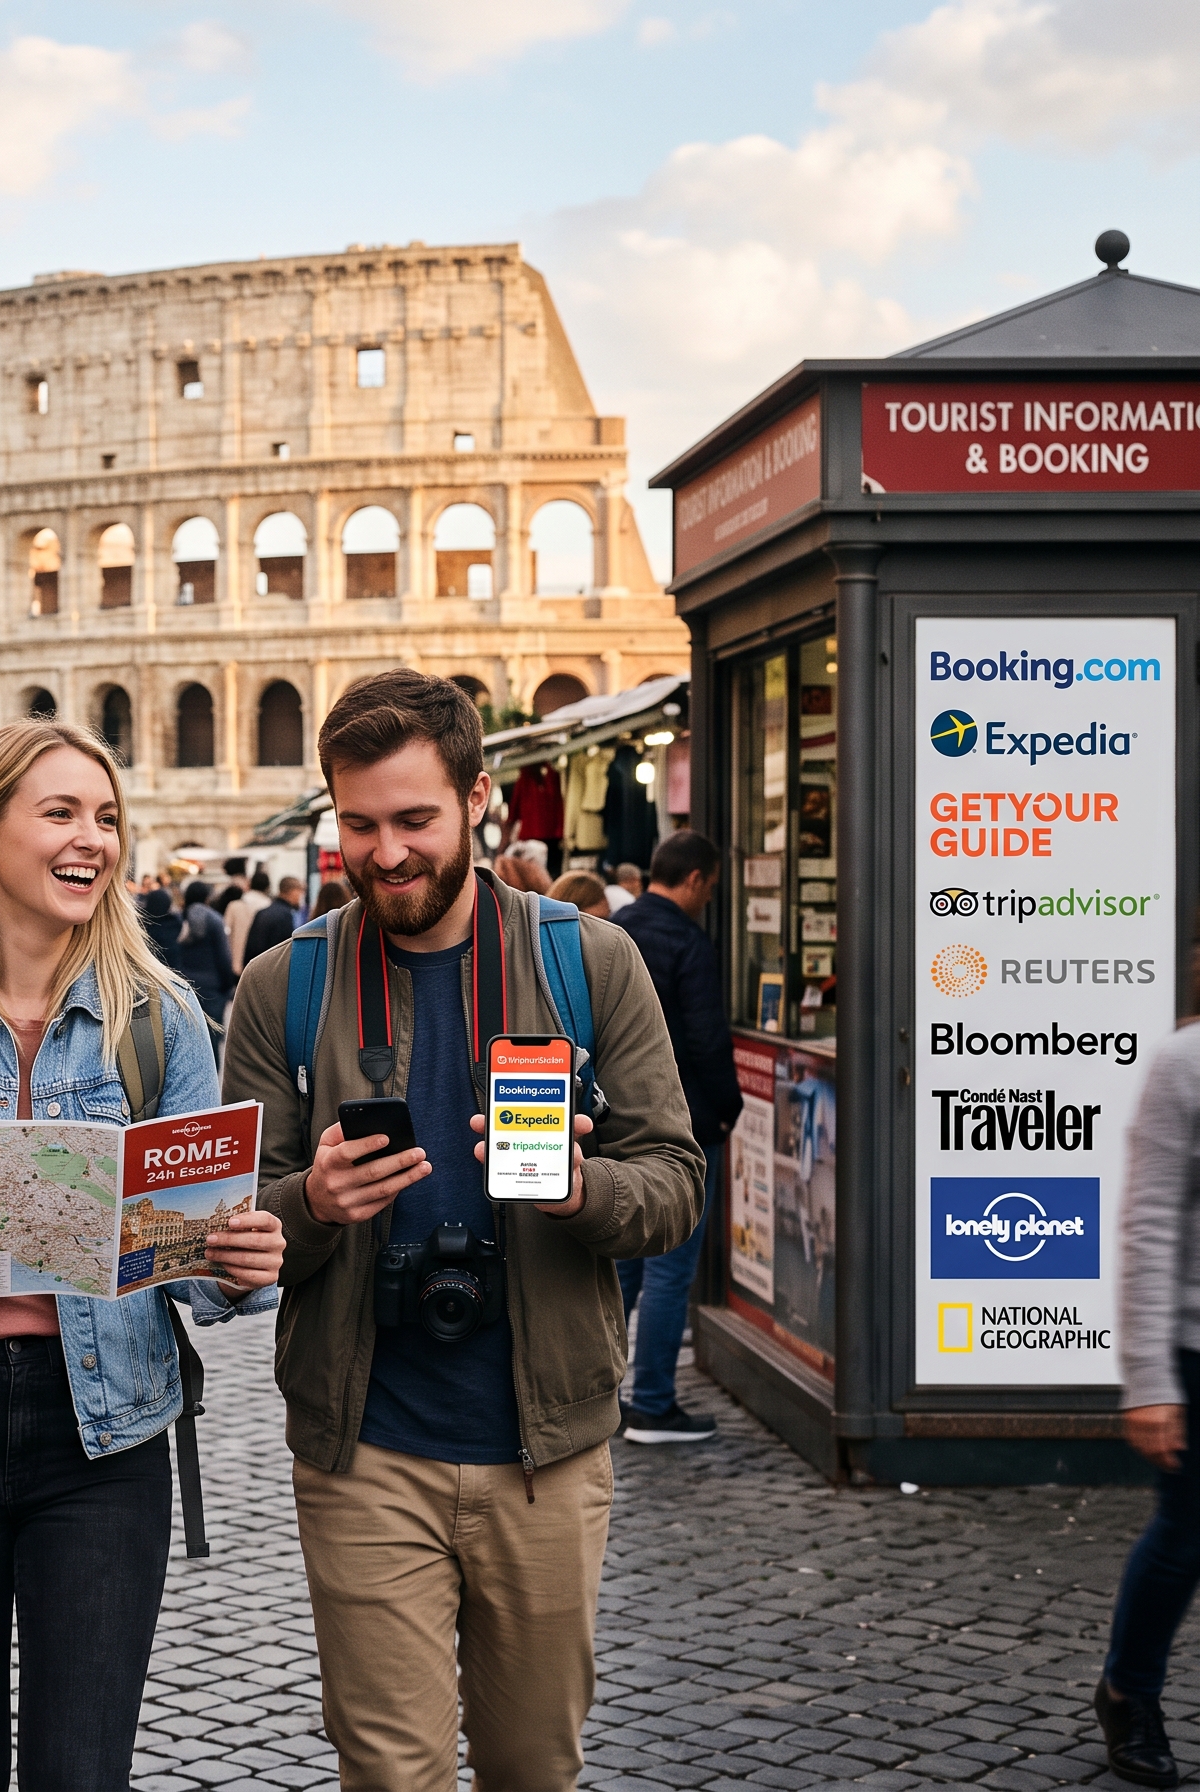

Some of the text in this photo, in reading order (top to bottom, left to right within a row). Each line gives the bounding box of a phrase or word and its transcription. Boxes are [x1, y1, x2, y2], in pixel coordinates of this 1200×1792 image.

[885, 402, 1013, 432] TOURIST
[965, 443, 1149, 474] & BOOKING
[931, 650, 1161, 689] Booking.com
[986, 721, 1131, 766] Expedia
[930, 792, 1119, 822] GETYOUR
[930, 828, 1052, 857] GUIDE
[983, 888, 1151, 923] tripadvisor
[1001, 960, 1155, 984] REUTERS
[931, 1022, 1137, 1065] Bloomberg
[499, 1086, 561, 1097] Booking.com
[960, 1089, 1043, 1103] Condé Nast
[515, 1114, 560, 1127] Expedia
[932, 1090, 1101, 1151] Traveler
[144, 1136, 239, 1169] ROME:
[512, 1142, 563, 1152] tripadvisor
[146, 1162, 231, 1183] 24h Escape
[945, 1214, 1084, 1243] lonely planet
[981, 1306, 1082, 1326] NATIONAL
[980, 1330, 1111, 1349] GEOGRAPHIC
